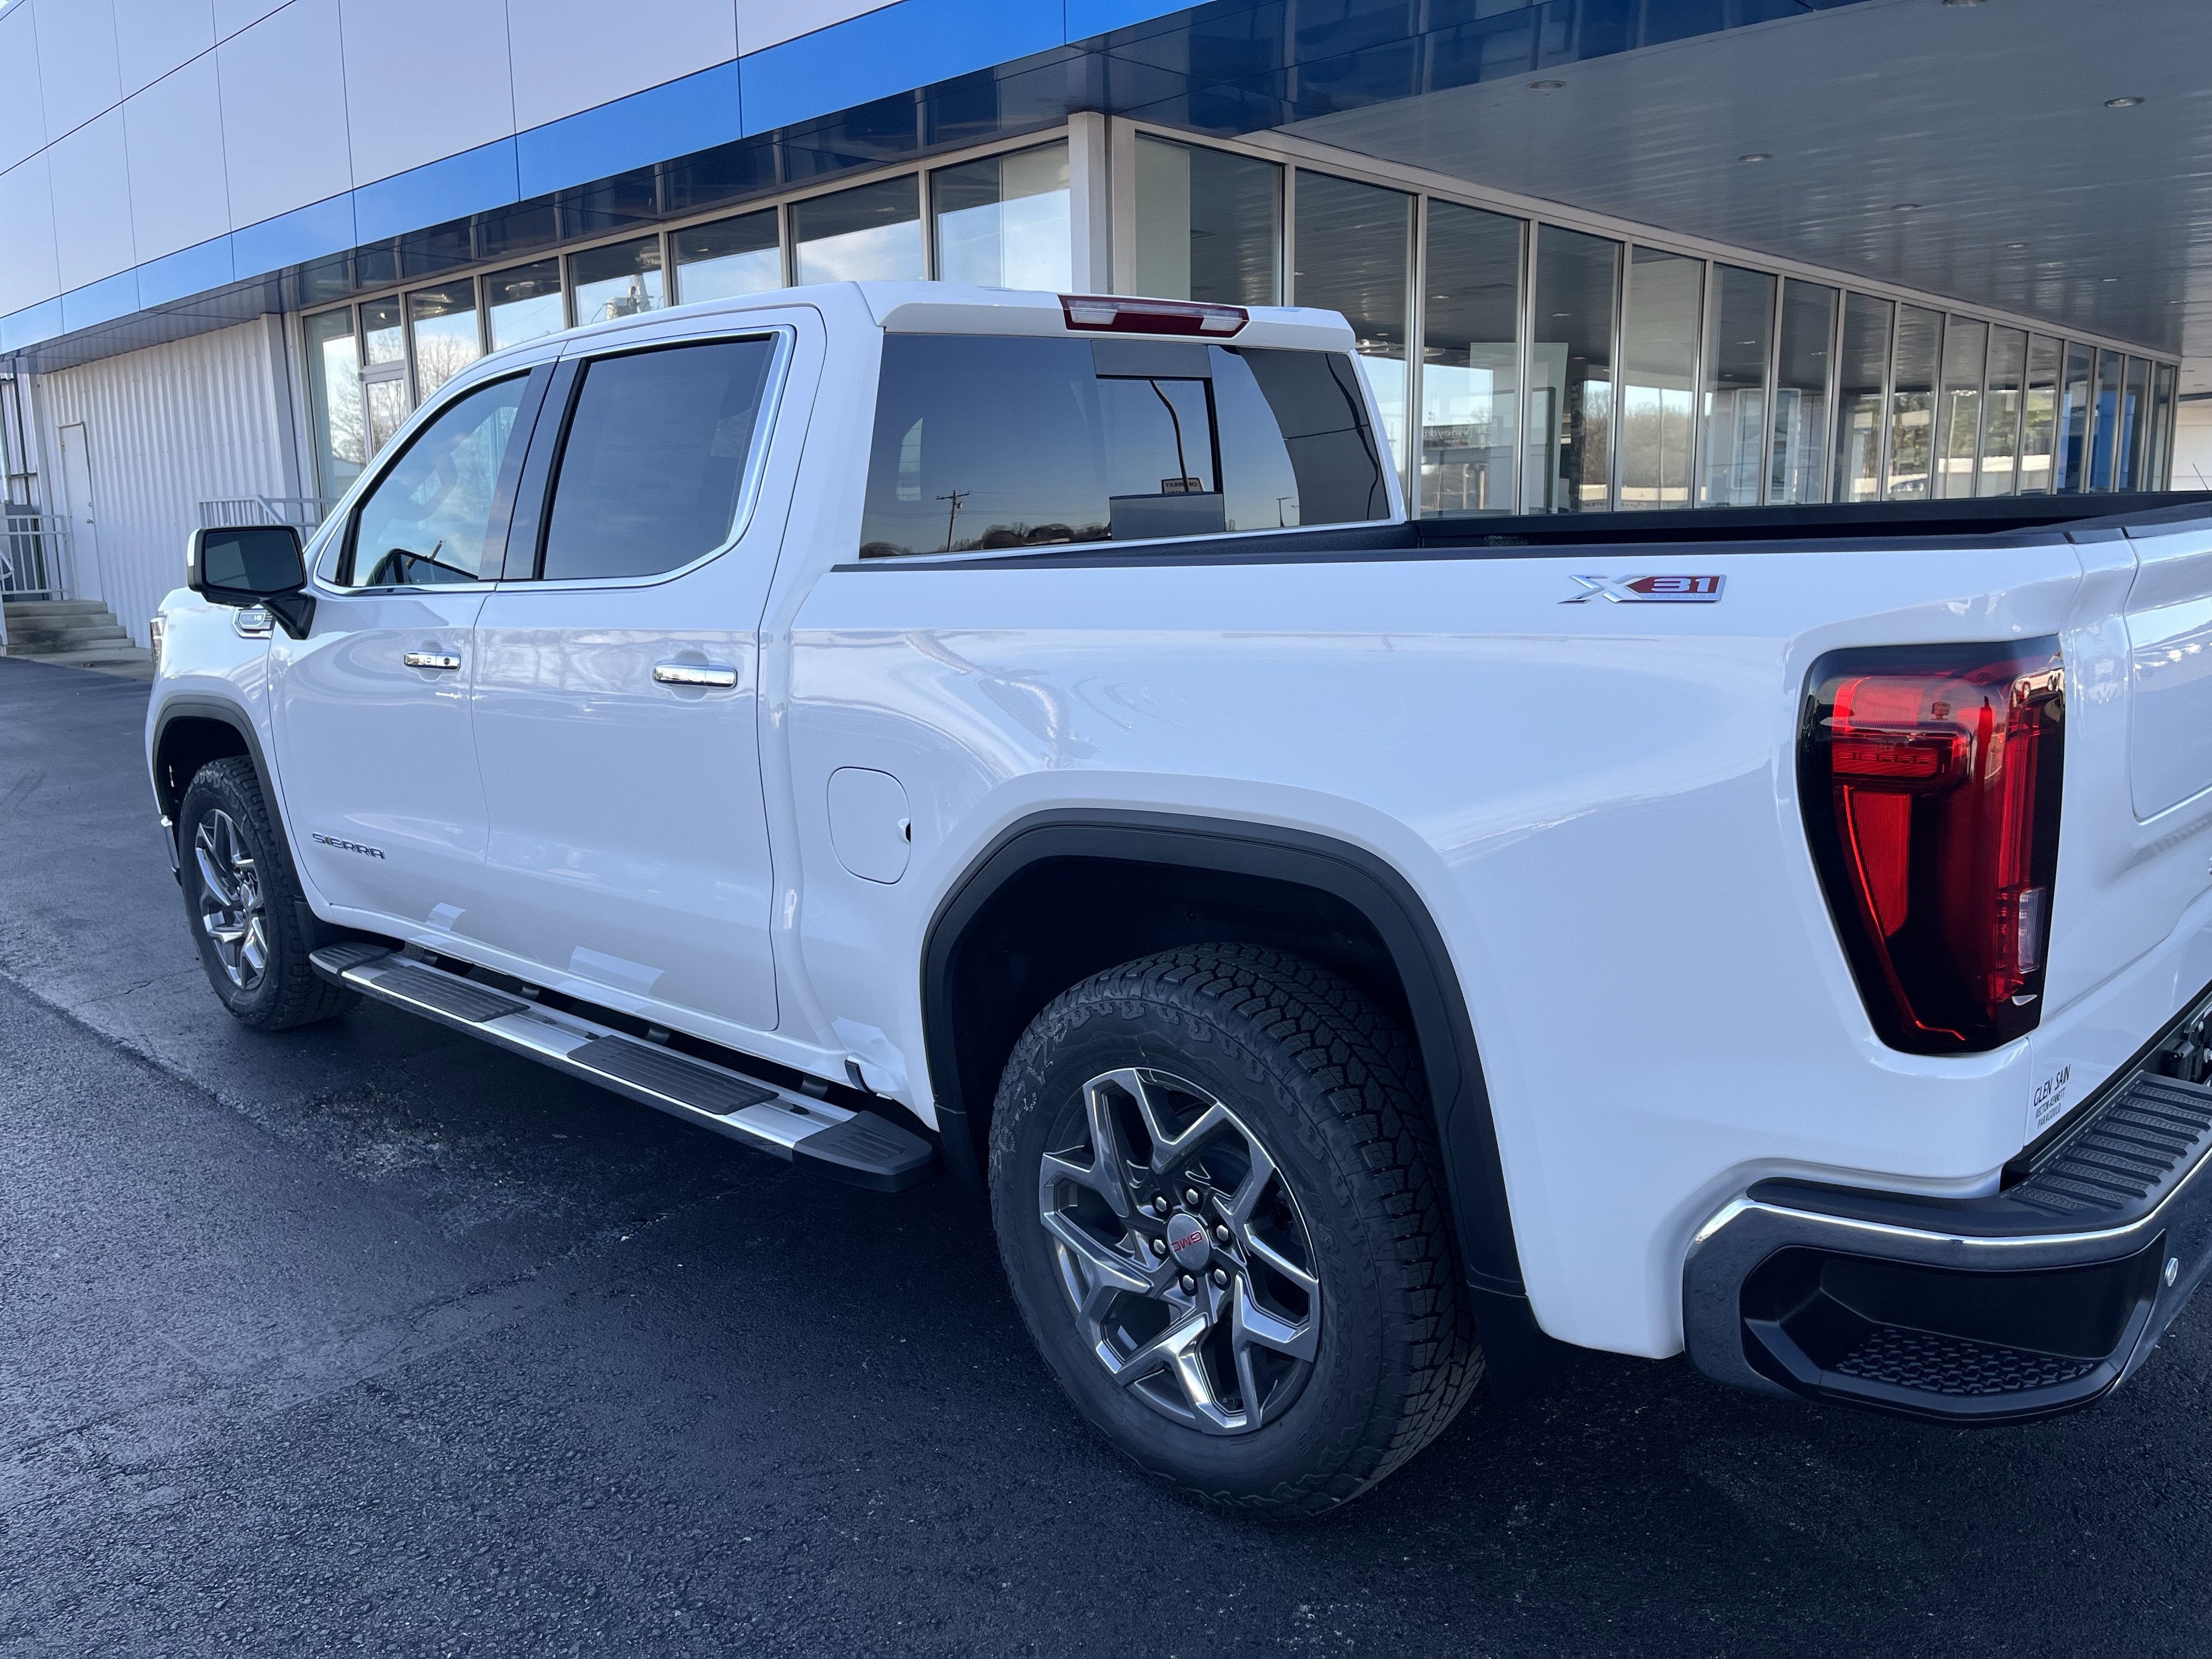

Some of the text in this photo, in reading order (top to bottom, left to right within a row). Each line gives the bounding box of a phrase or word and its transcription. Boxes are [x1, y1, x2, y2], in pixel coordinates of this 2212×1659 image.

[312, 832, 386, 860] SIERRA
[2034, 1063, 2071, 1107] GLEN SAIN
[1171, 1230, 1203, 1252] GMC
